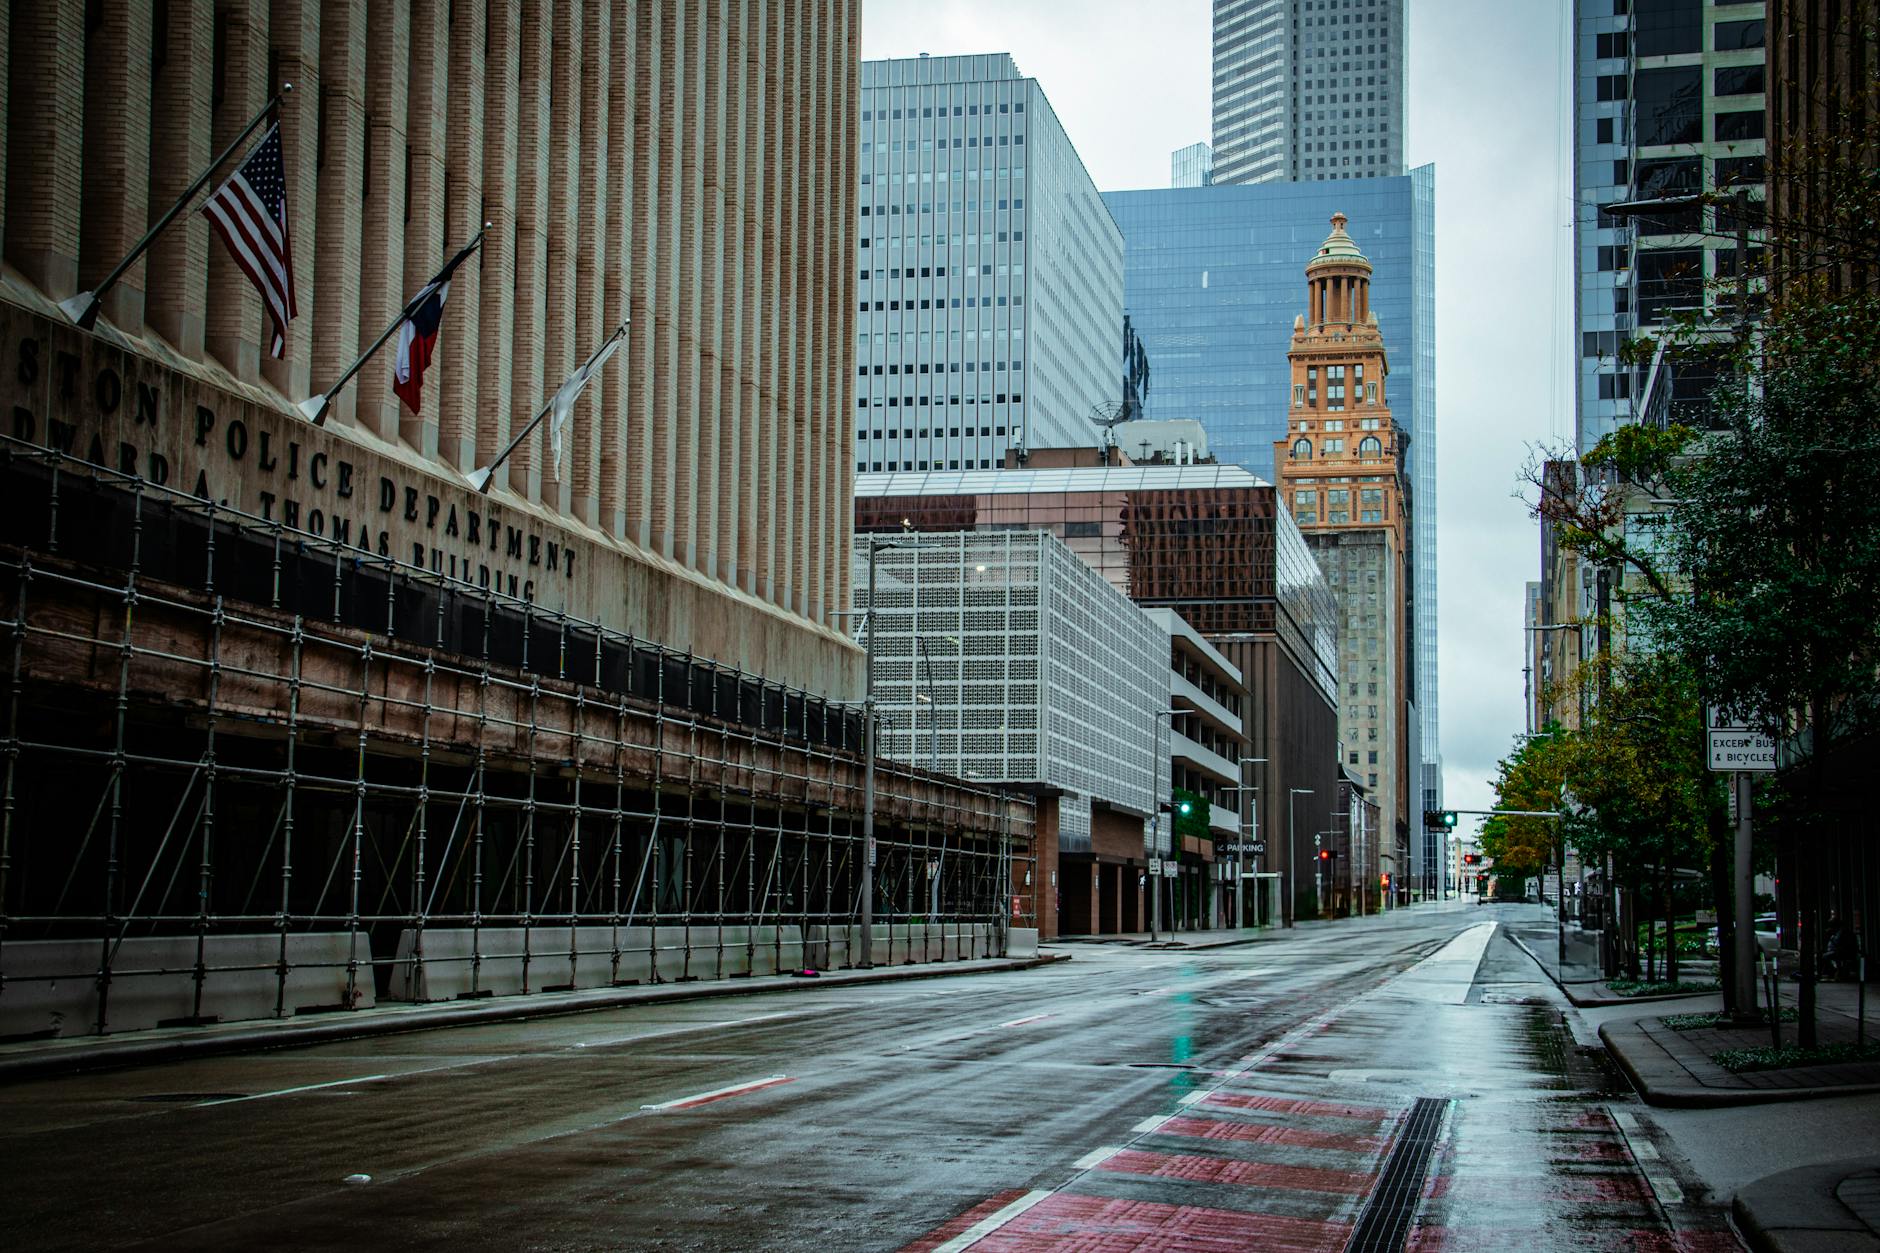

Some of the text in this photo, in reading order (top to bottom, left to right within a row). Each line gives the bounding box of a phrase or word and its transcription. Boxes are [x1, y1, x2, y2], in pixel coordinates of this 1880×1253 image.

[14, 405, 169, 486] DWARD
[260, 490, 389, 557] THOMAS
[413, 542, 535, 602] BUILDING
[18, 338, 576, 579] STON POLICE DEPARTMENT
[1715, 753, 1775, 762] & BICYCLES
[1756, 739, 1775, 748] BUS
